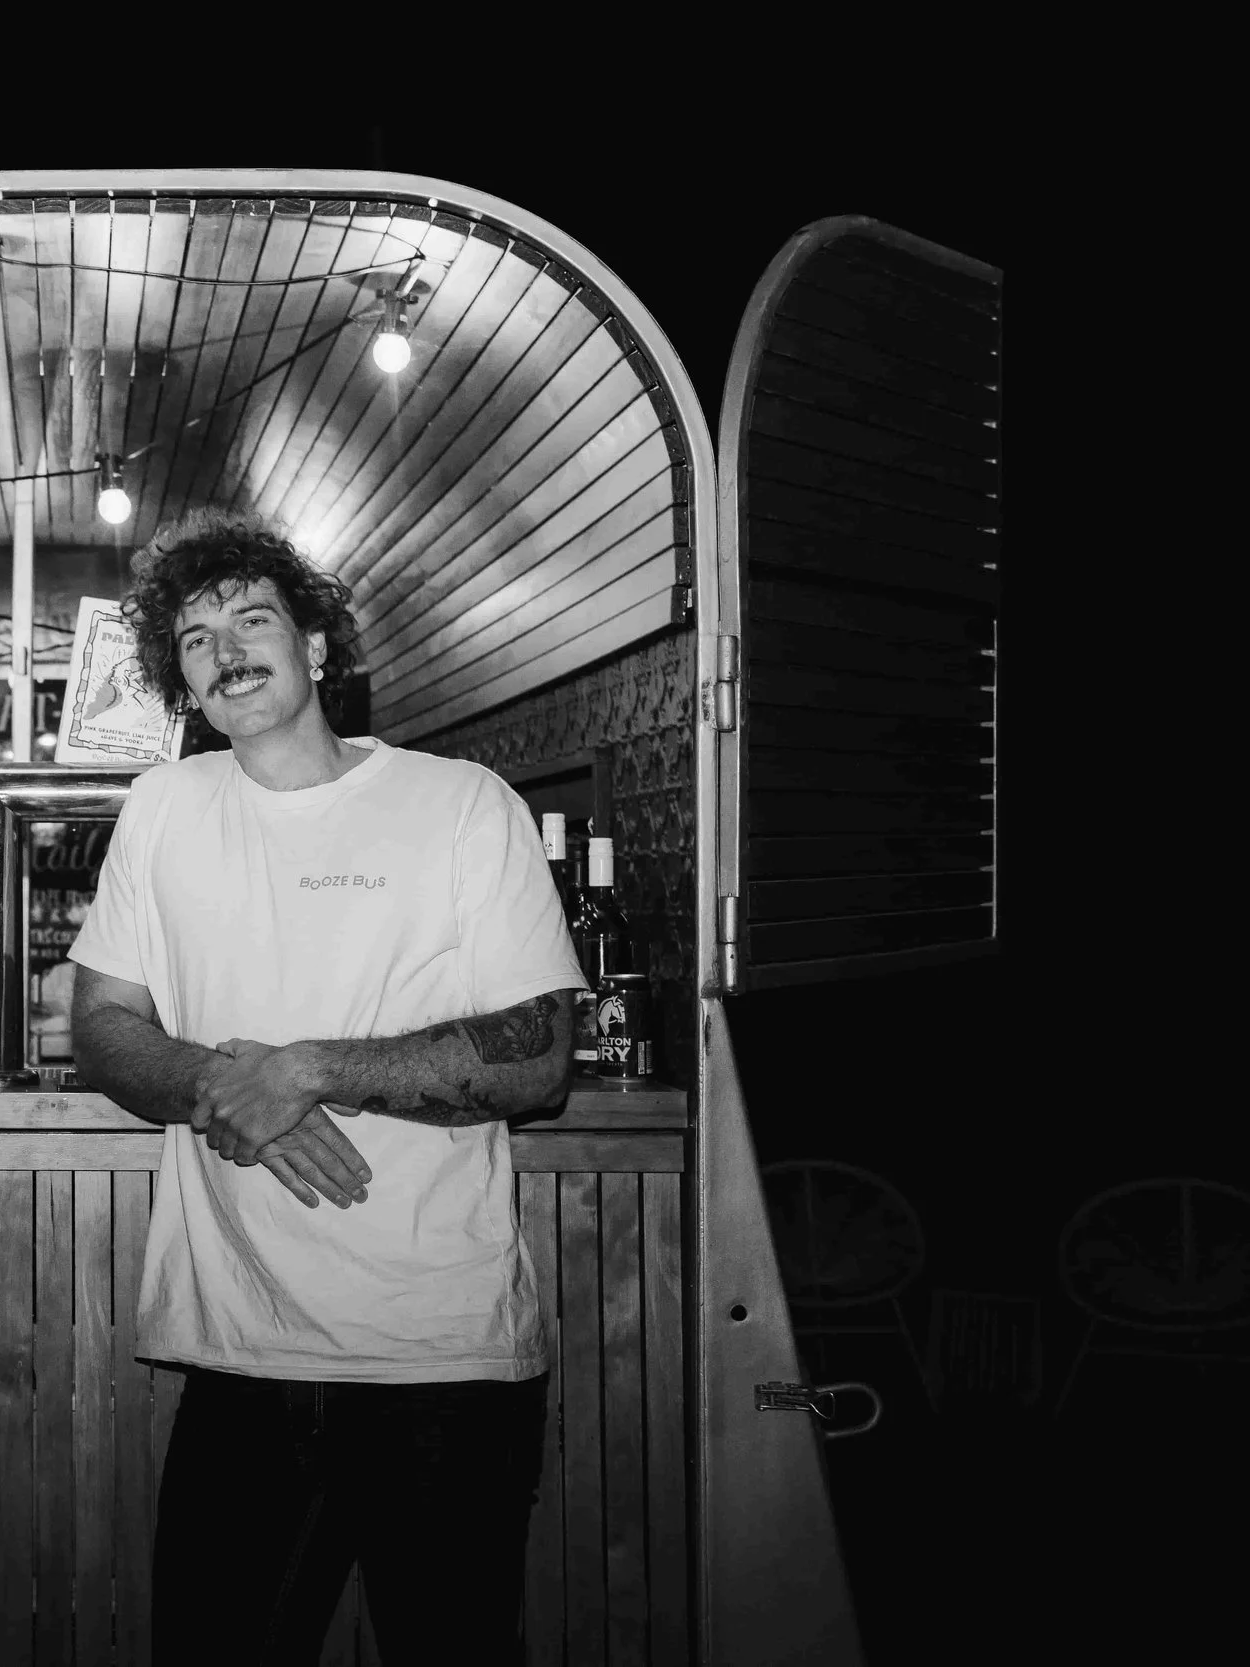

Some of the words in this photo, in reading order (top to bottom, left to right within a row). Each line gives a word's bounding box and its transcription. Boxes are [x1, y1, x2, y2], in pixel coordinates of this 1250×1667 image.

[299, 875, 349, 890] BOOZE
[353, 875, 387, 889] BUS
[598, 1037, 631, 1046] RLTON
